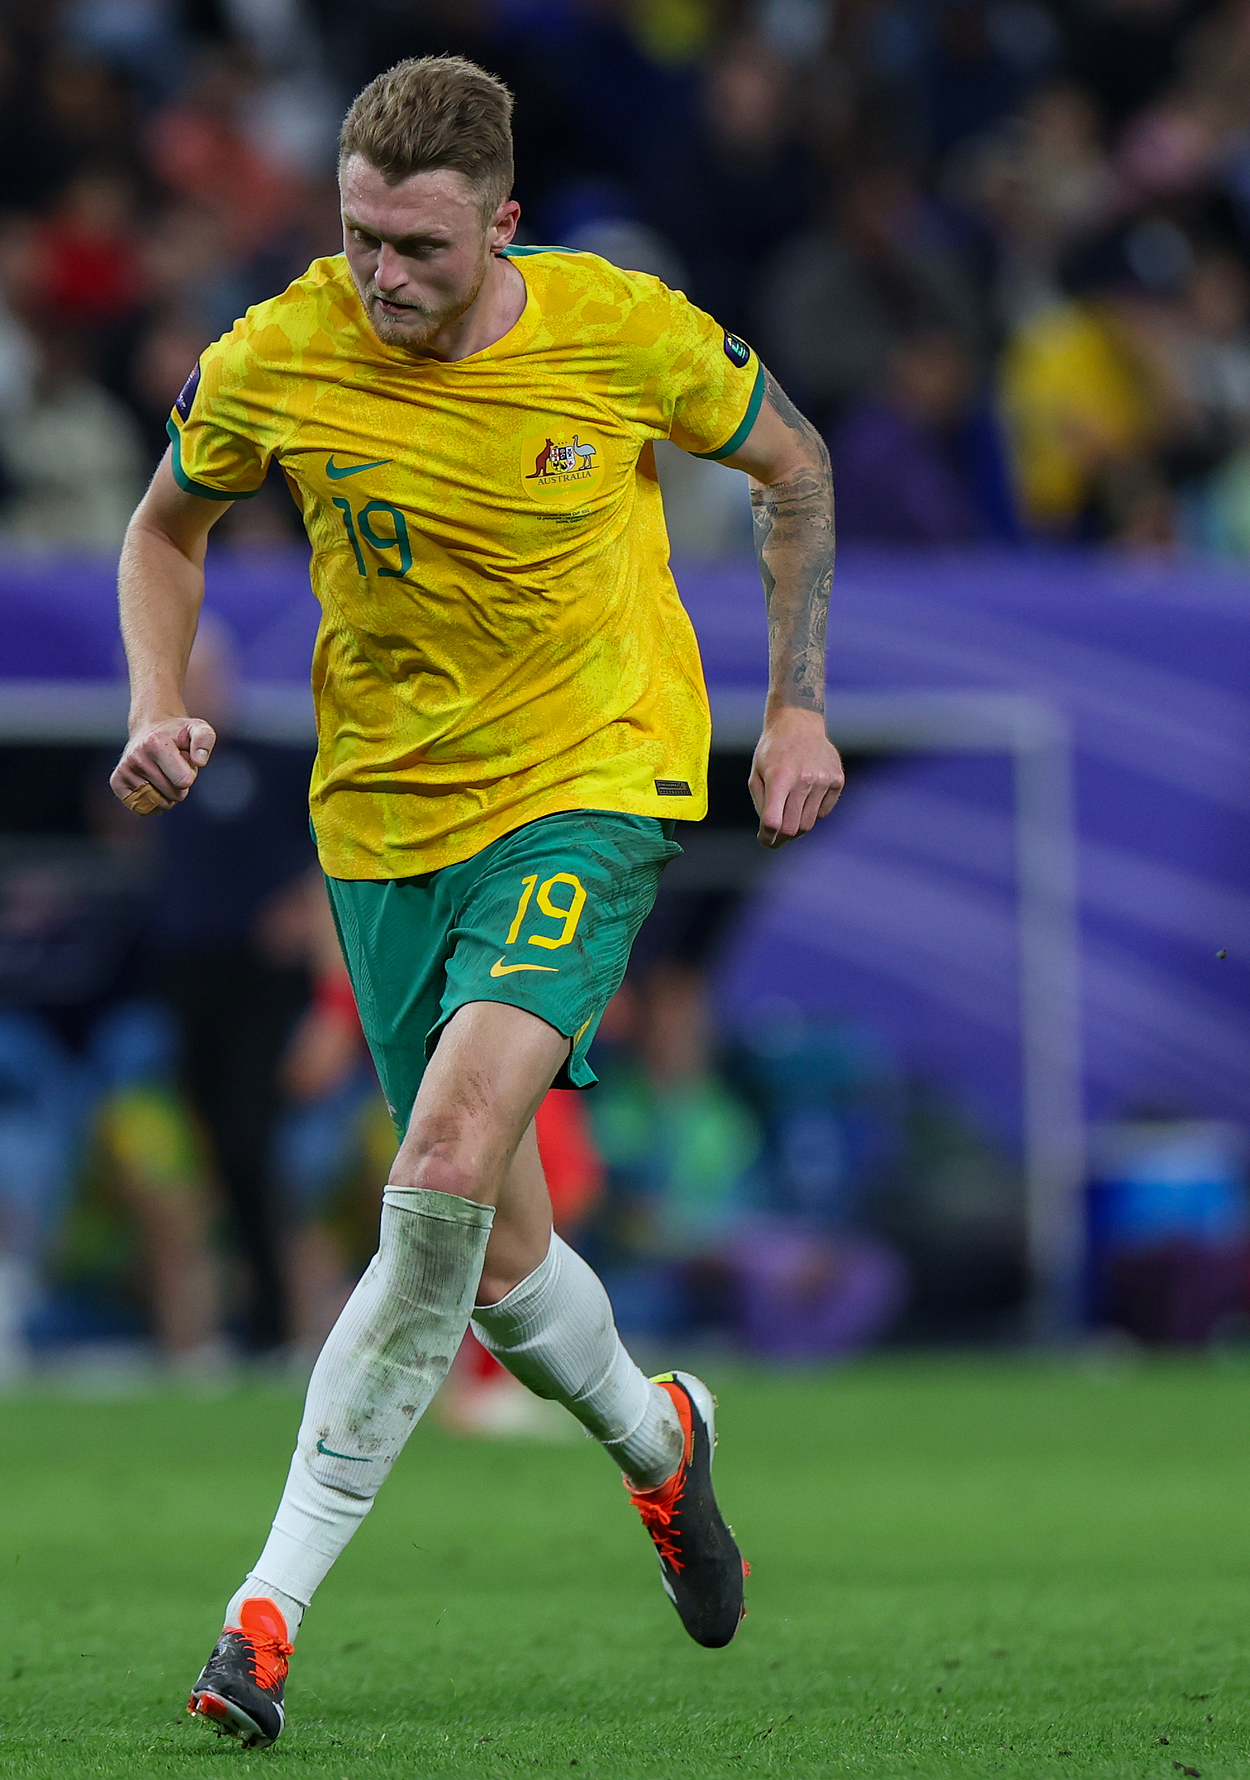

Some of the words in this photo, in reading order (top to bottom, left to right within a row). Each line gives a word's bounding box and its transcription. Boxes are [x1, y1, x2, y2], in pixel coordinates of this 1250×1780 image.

[537, 471, 592, 485] AUSTRALIA
[331, 496, 414, 579] 19
[504, 872, 588, 950] 19
